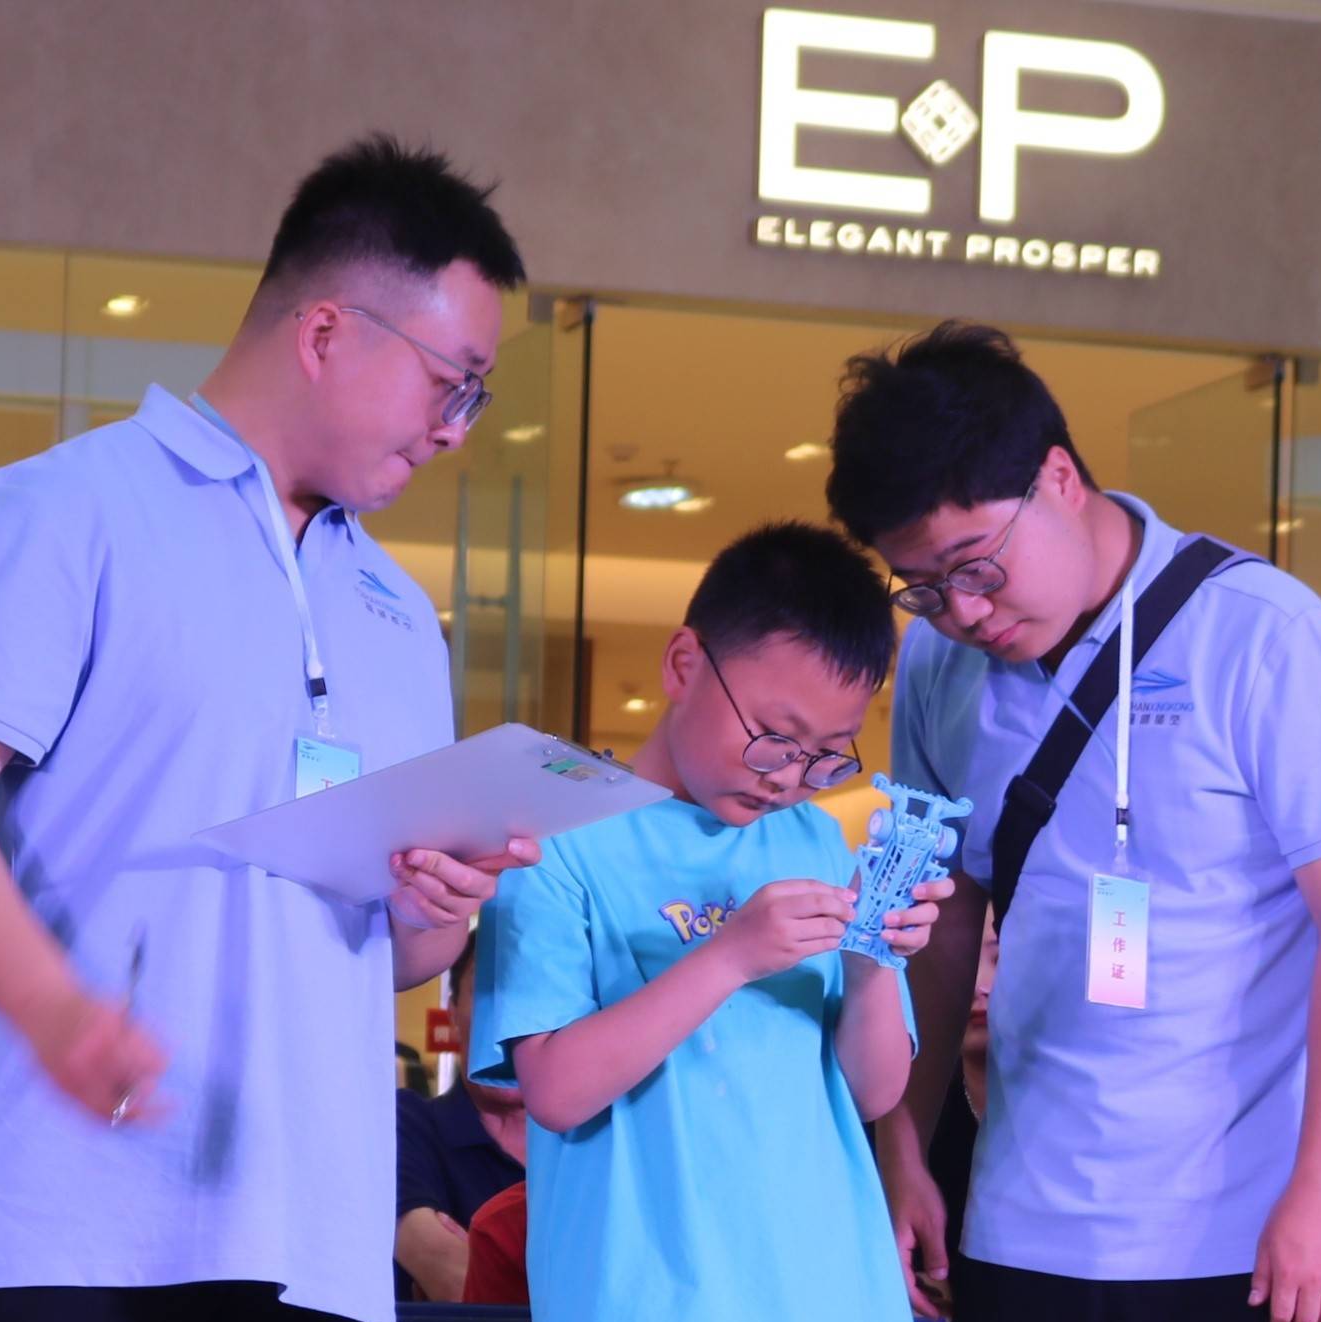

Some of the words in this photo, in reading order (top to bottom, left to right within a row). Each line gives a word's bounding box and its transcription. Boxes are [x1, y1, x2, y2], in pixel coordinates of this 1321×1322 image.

[756, 216, 950, 258] ELEGANT
[966, 234, 1161, 276] PROSPER
[1112, 910, 1127, 980] 工作证
